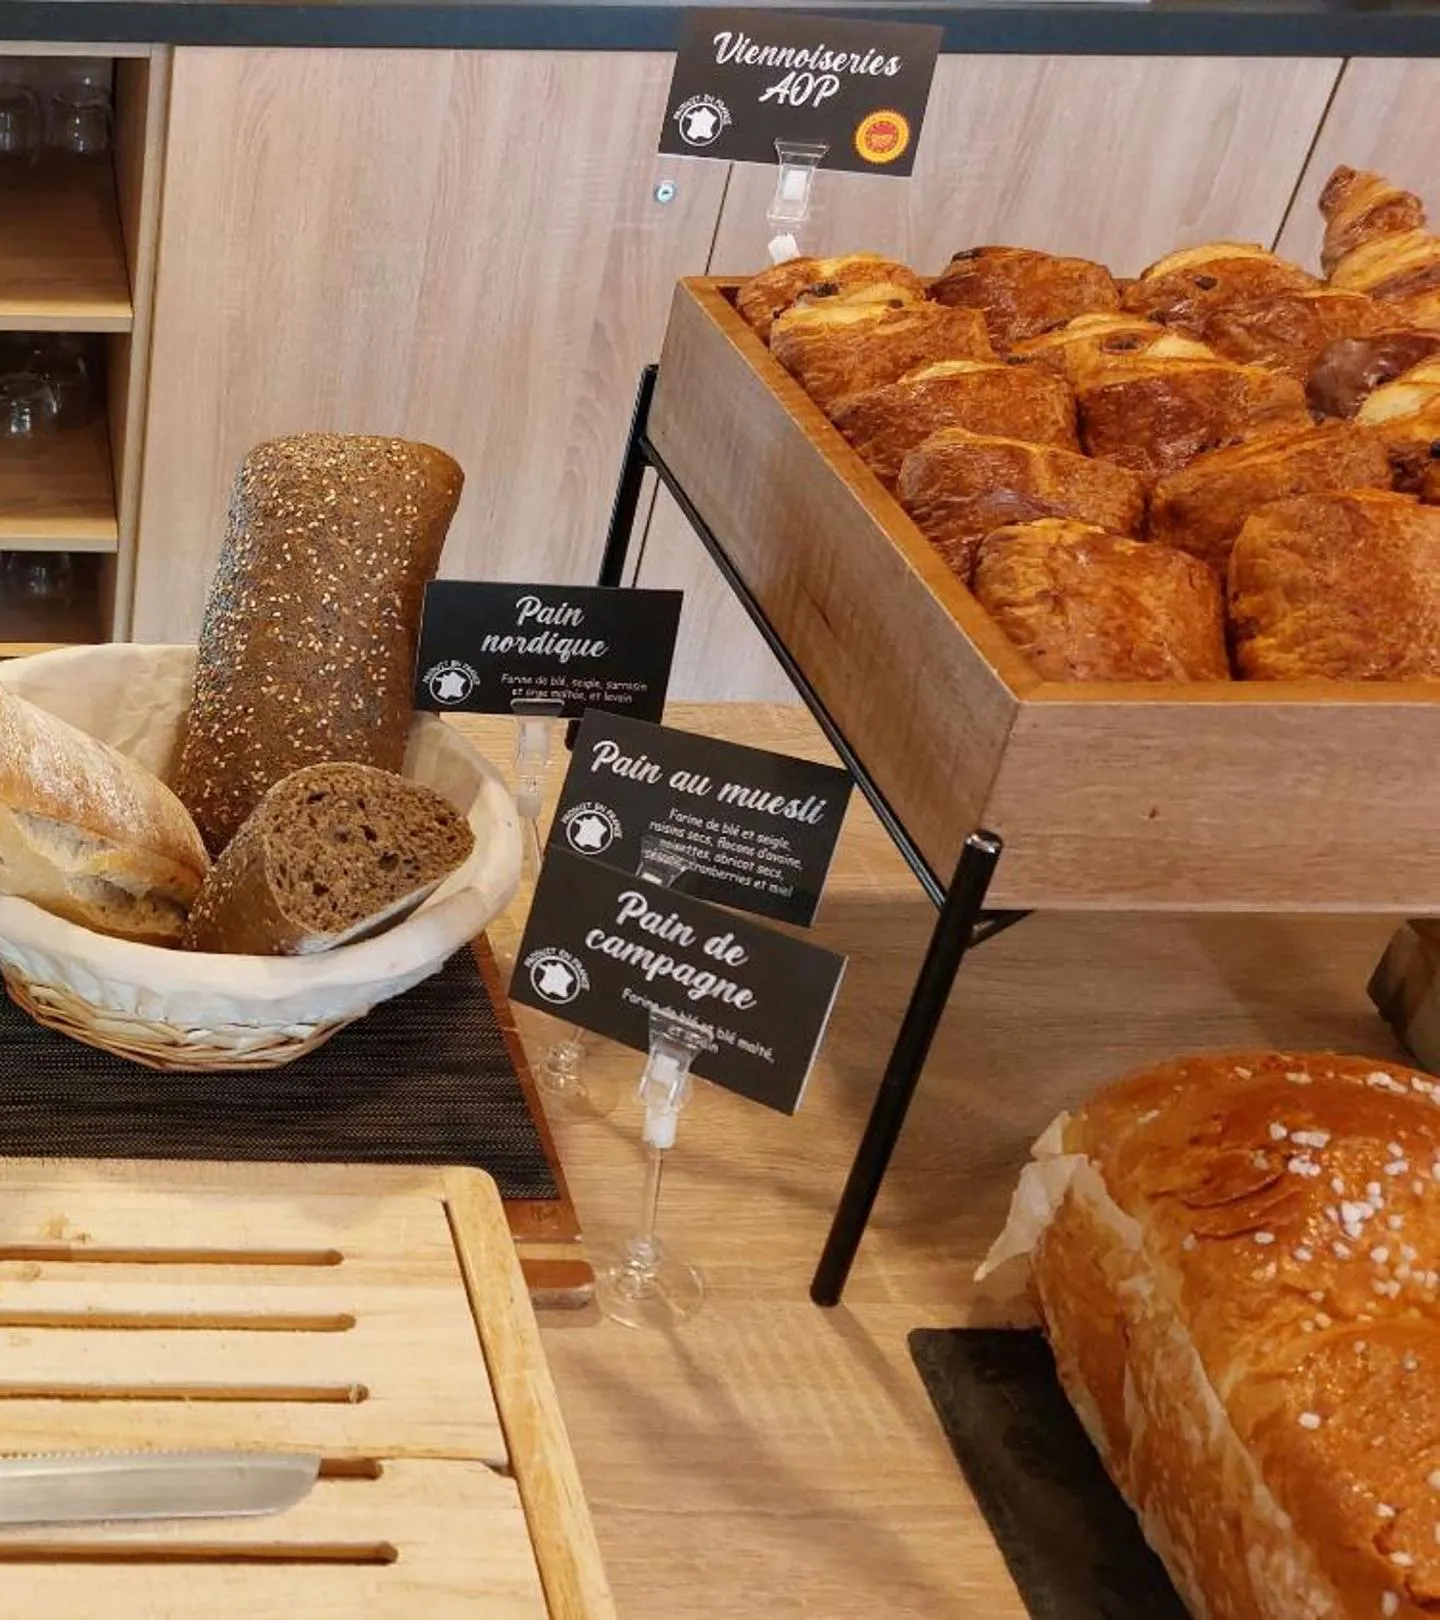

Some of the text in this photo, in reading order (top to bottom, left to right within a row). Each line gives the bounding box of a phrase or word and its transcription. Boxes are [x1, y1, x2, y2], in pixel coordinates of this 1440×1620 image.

[713, 31, 902, 77] Viennoiseries
[758, 71, 840, 108] AOP
[516, 595, 585, 627] Pain
[480, 630, 609, 664] nordique
[591, 740, 827, 825] Pain au muesli
[669, 806, 704, 829] Farine
[706, 818, 720, 832] de
[617, 891, 750, 967] Pain de
[585, 928, 757, 1011] campagne
